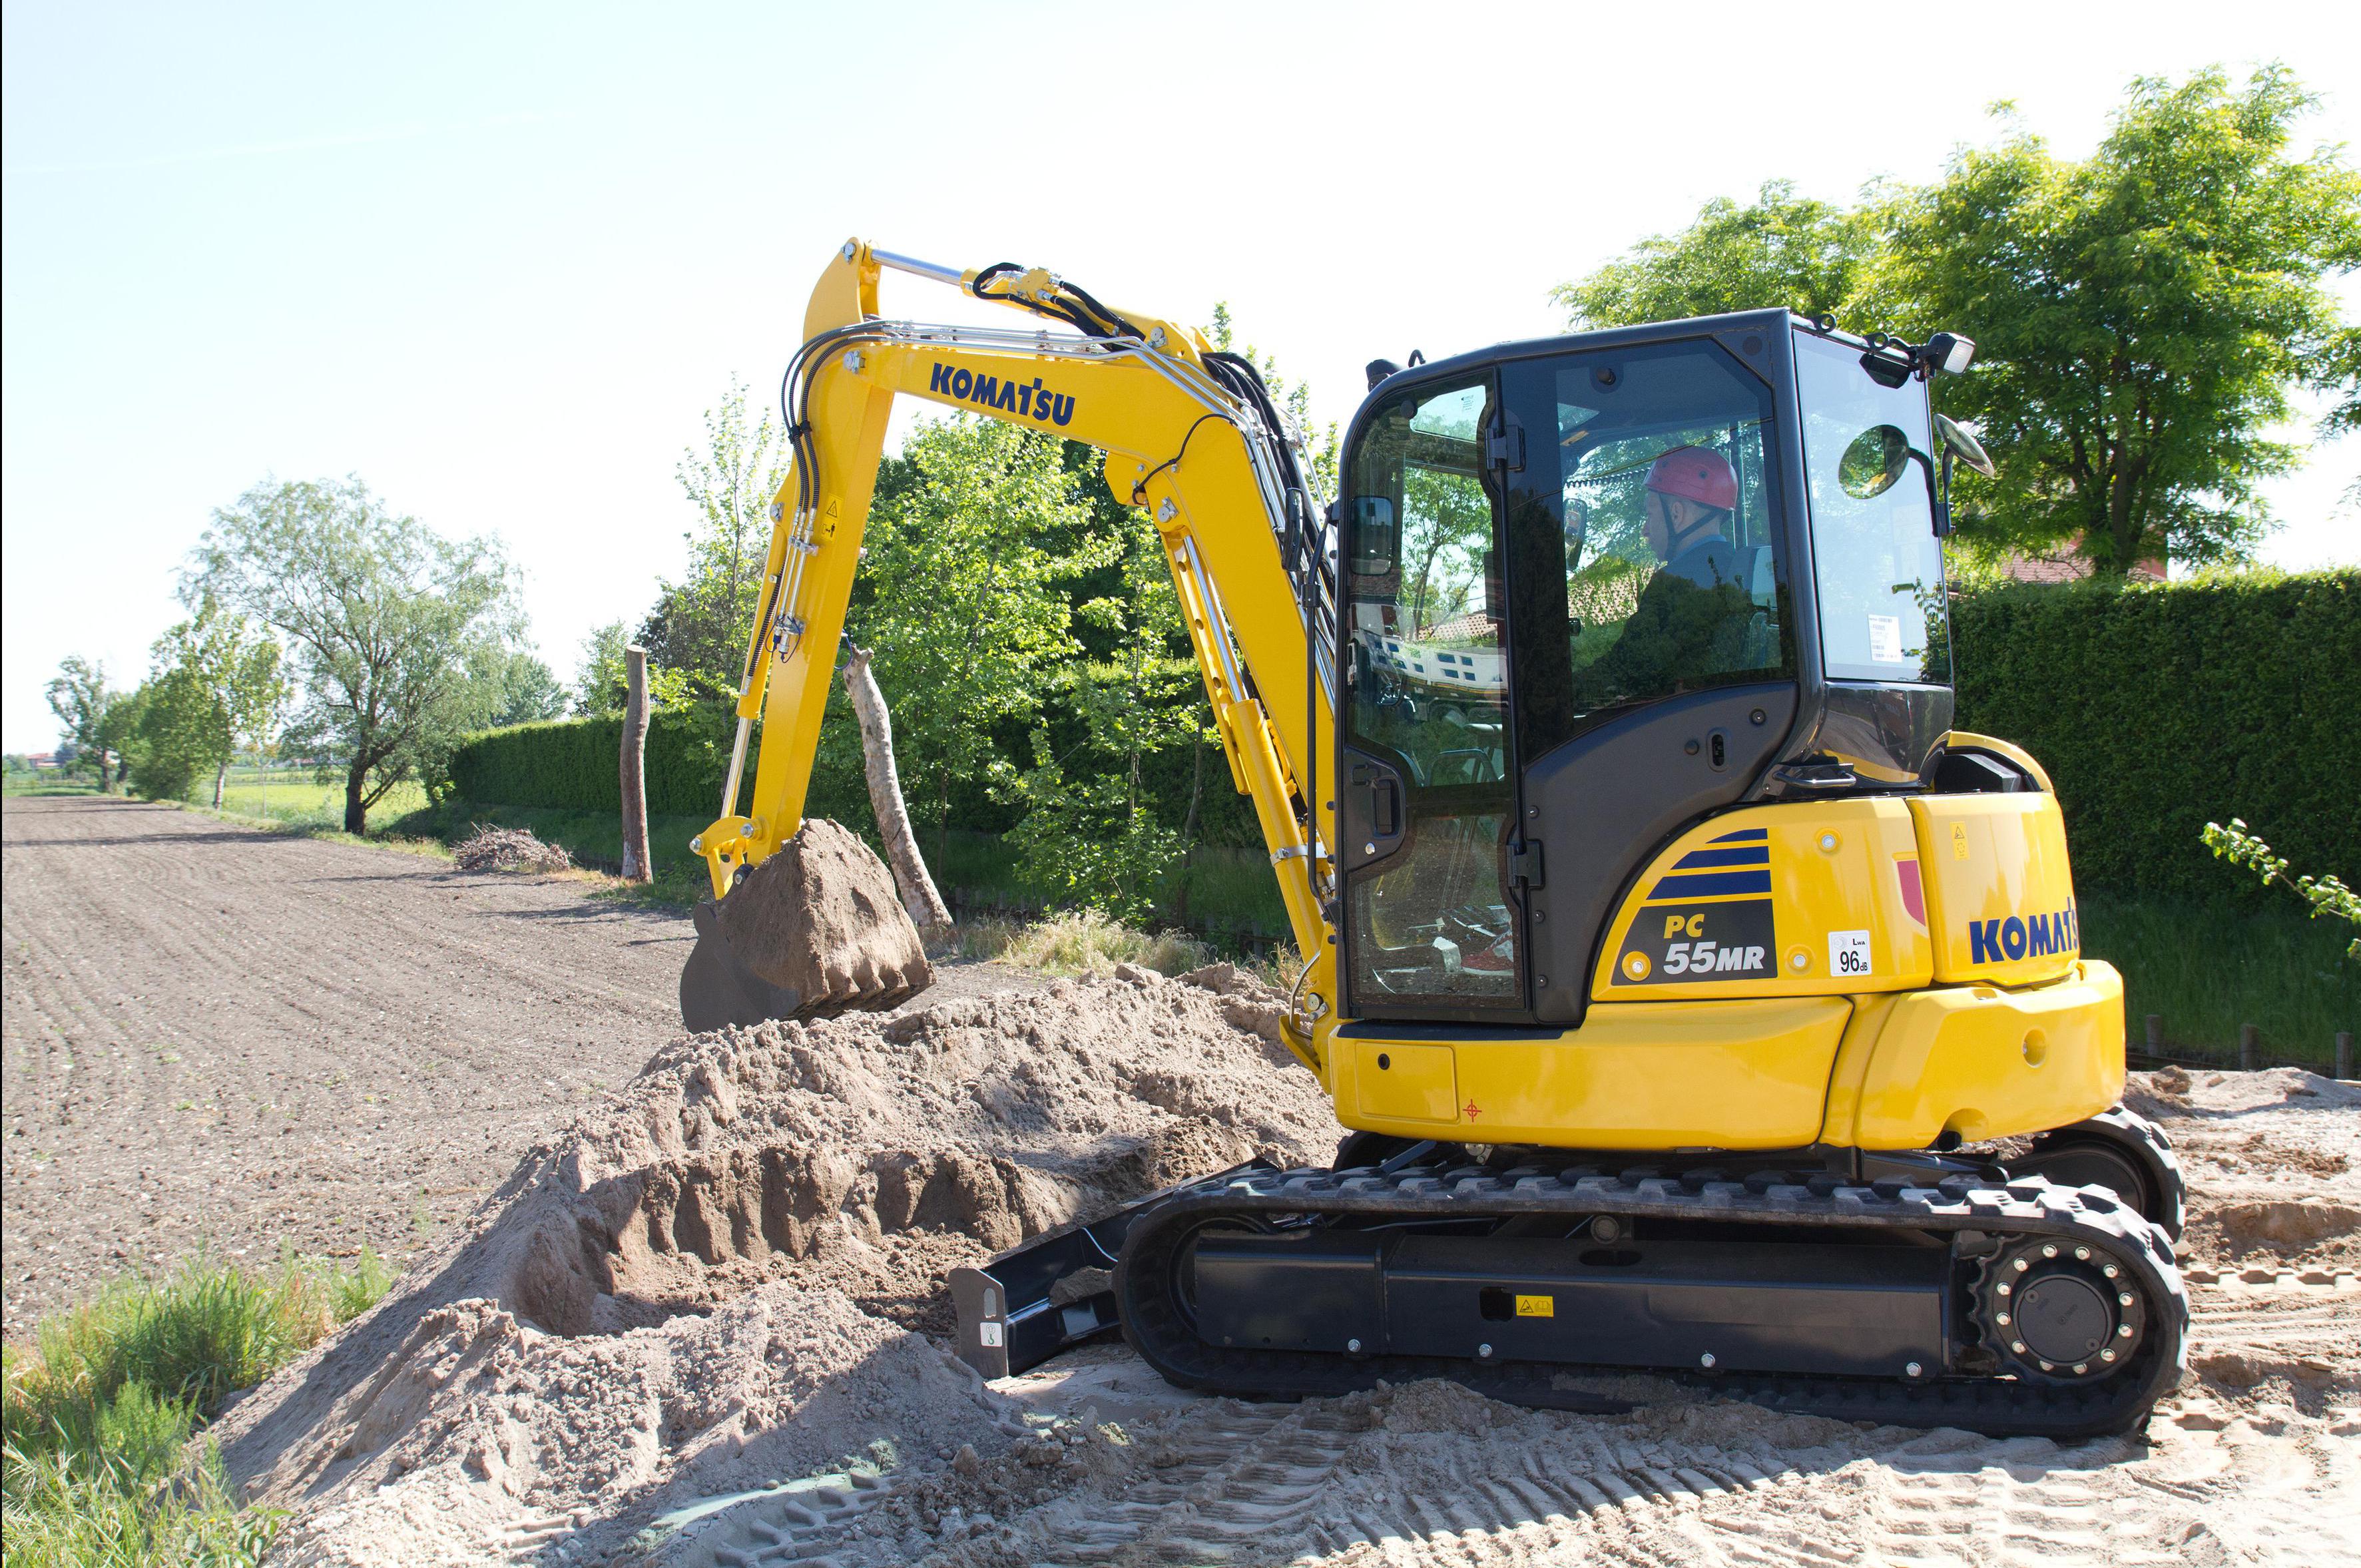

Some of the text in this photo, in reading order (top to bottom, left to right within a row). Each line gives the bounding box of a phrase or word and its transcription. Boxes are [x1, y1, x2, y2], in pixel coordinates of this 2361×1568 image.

[929, 362, 1075, 426] KOMATSU
[1663, 914, 1705, 939] PC
[1663, 941, 1764, 975] 55MR
[1840, 951, 1860, 973] 96
